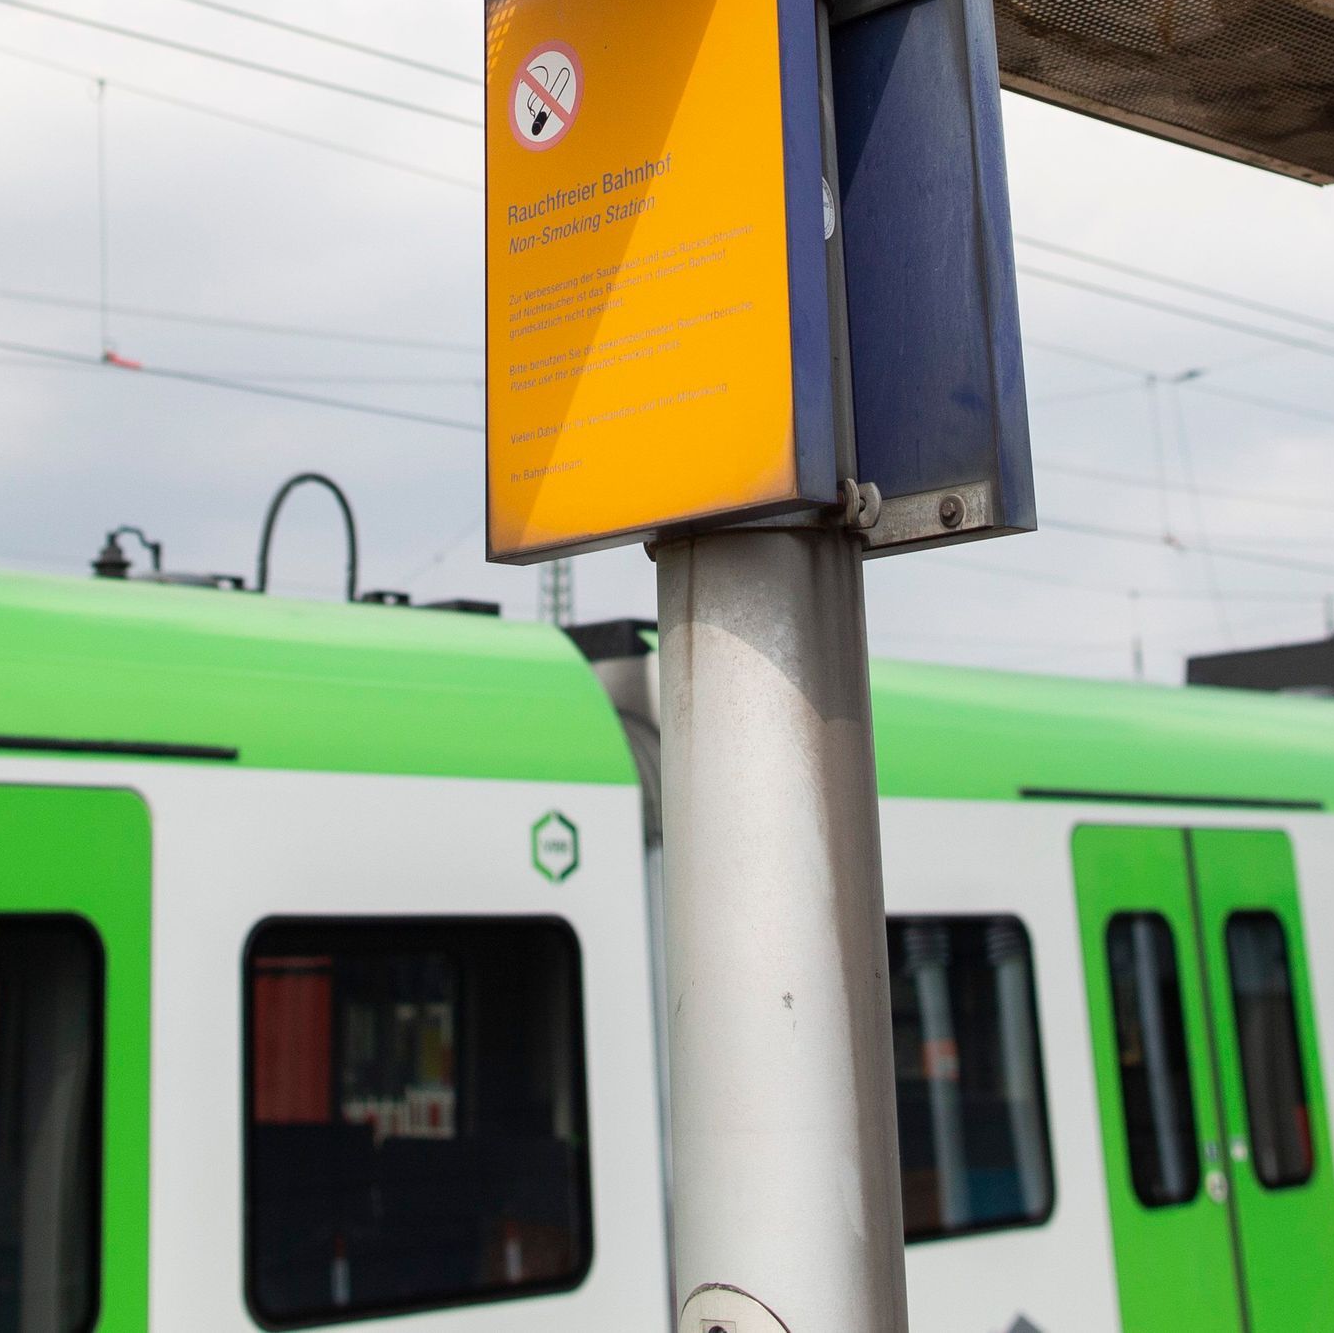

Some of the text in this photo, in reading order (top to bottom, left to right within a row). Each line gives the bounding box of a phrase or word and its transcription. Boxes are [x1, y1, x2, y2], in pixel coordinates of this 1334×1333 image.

[507, 151, 672, 227] Rauchfreier Bahnhof
[508, 194, 656, 255] Non-Smoking Station
[524, 277, 579, 301] Verbesserung
[580, 272, 594, 284] der
[588, 287, 604, 299] das
